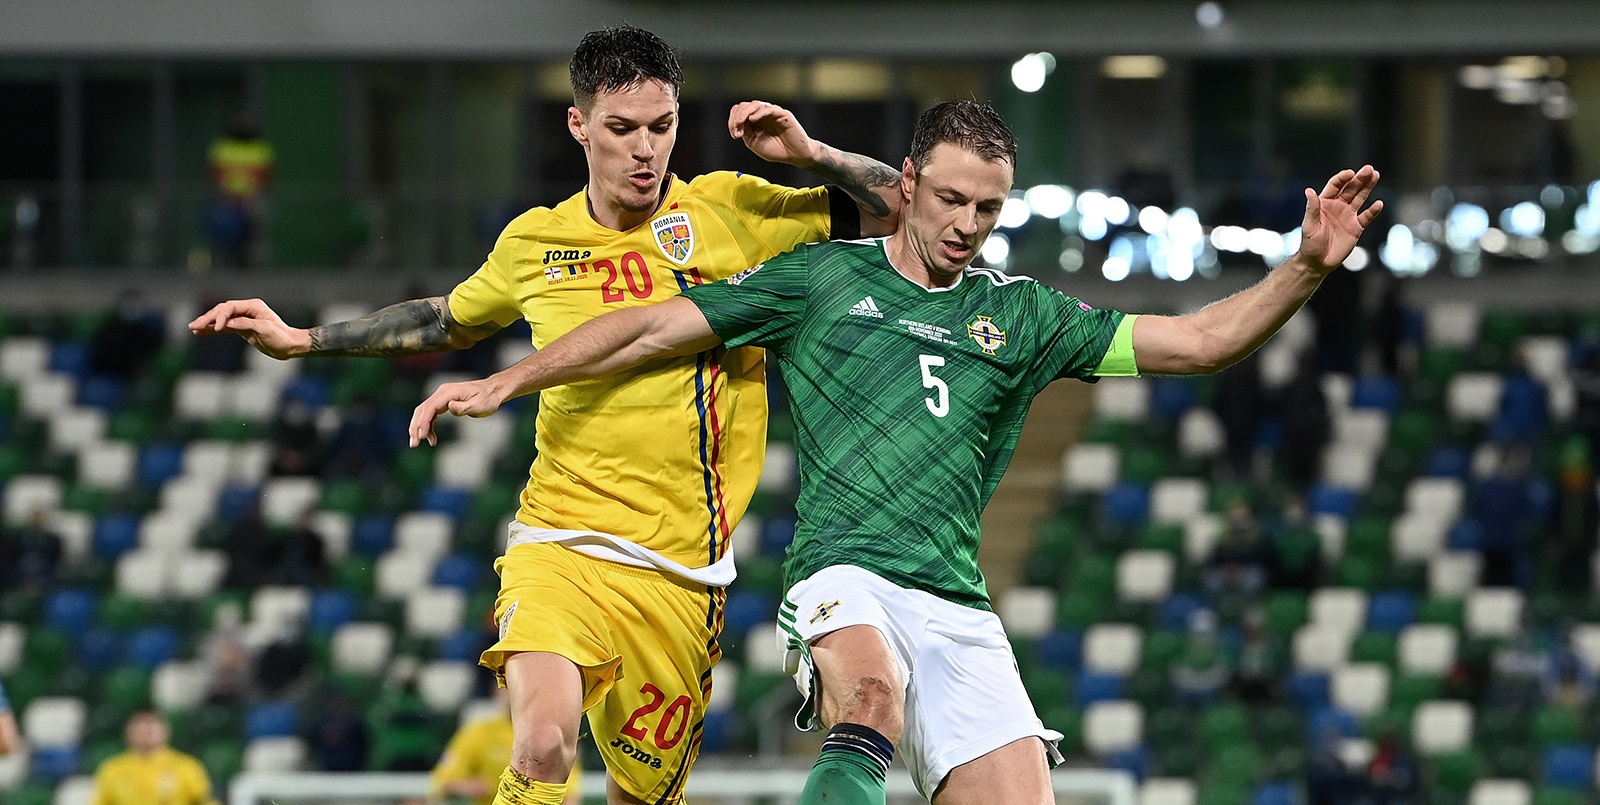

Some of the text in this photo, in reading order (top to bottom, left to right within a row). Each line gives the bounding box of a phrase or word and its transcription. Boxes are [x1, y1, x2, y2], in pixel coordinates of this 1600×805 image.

[592, 251, 653, 303] 20
[848, 308, 884, 319] adidas
[919, 354, 950, 418] 5
[620, 683, 692, 750] 20
